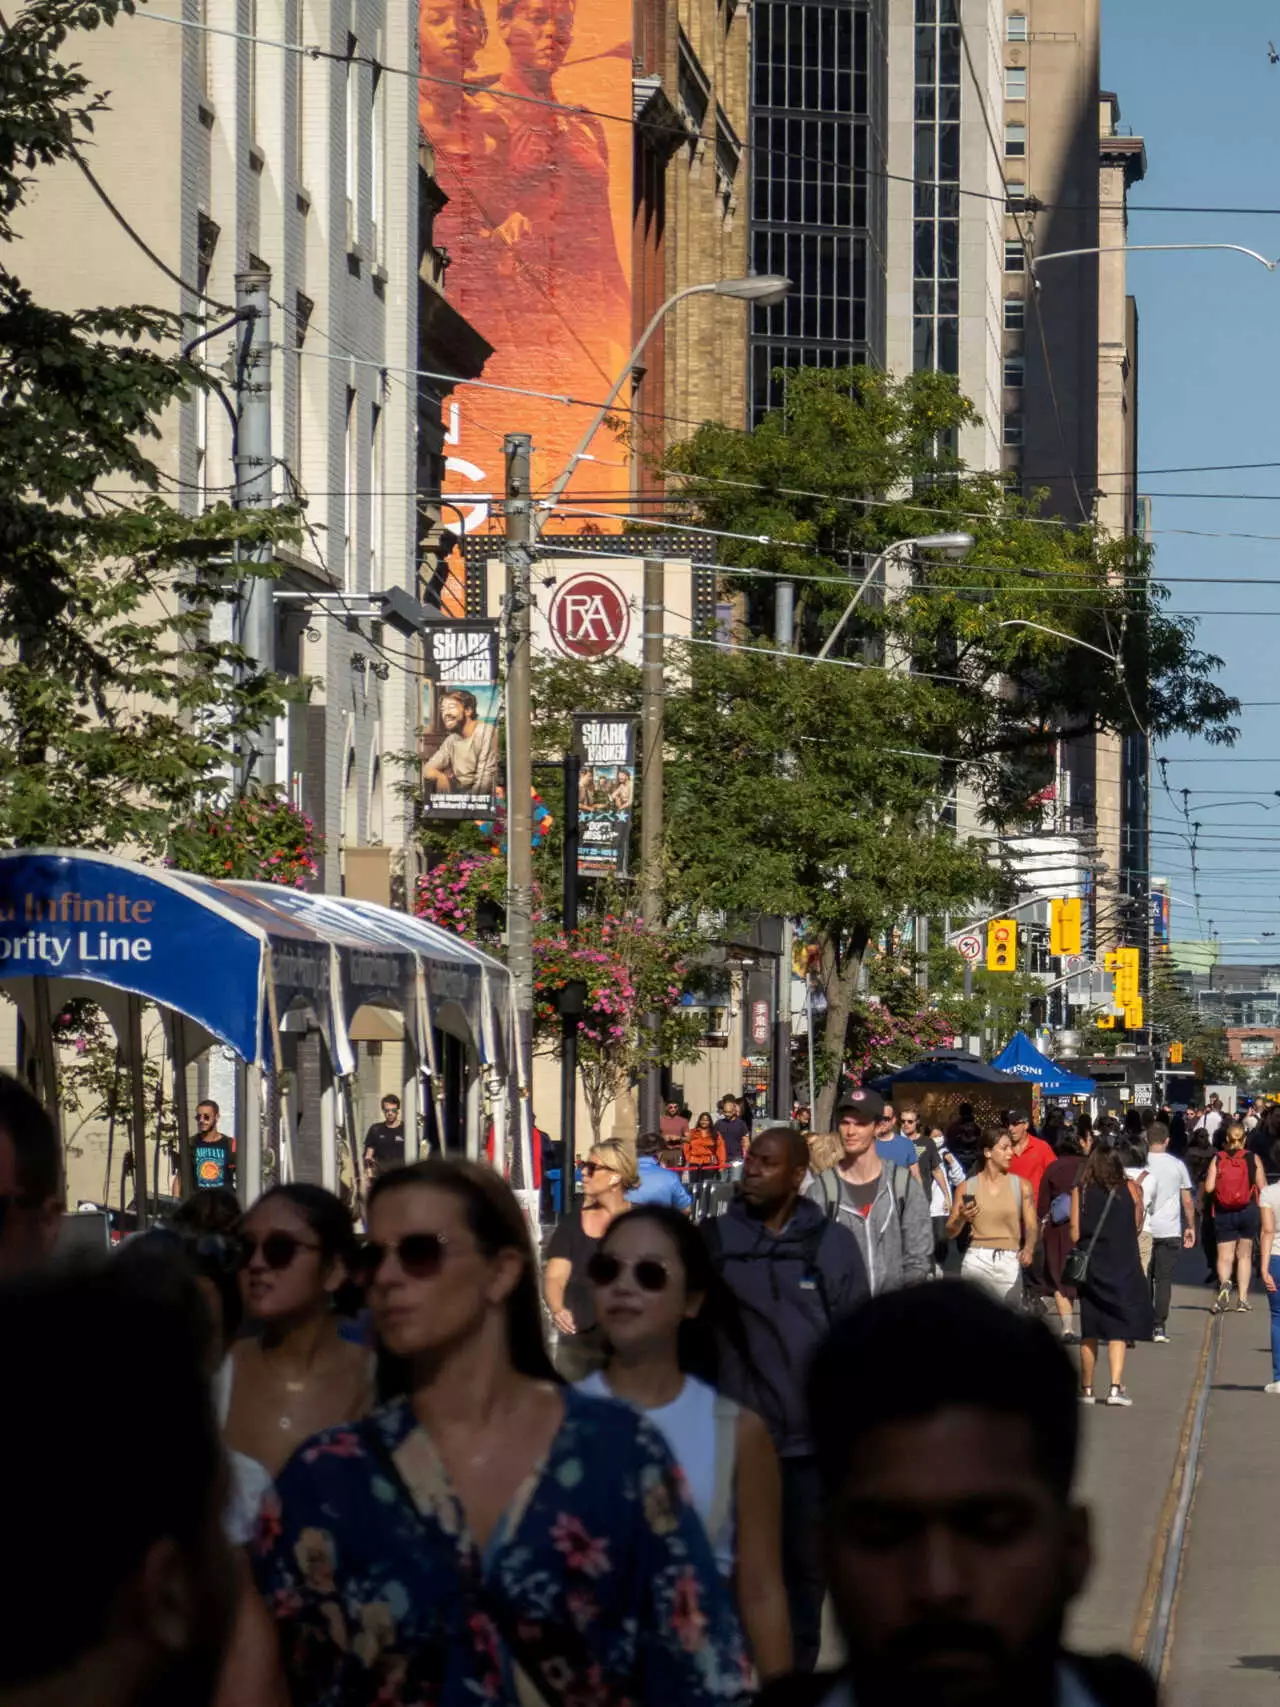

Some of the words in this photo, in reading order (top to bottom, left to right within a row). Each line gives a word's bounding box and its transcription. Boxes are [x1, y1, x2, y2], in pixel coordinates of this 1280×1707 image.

[433, 632, 491, 660] SHARK
[440, 660, 491, 681] BROKEN
[582, 723, 629, 744] SHARK
[25, 892, 153, 924] Infinite
[79, 931, 152, 961] Line
